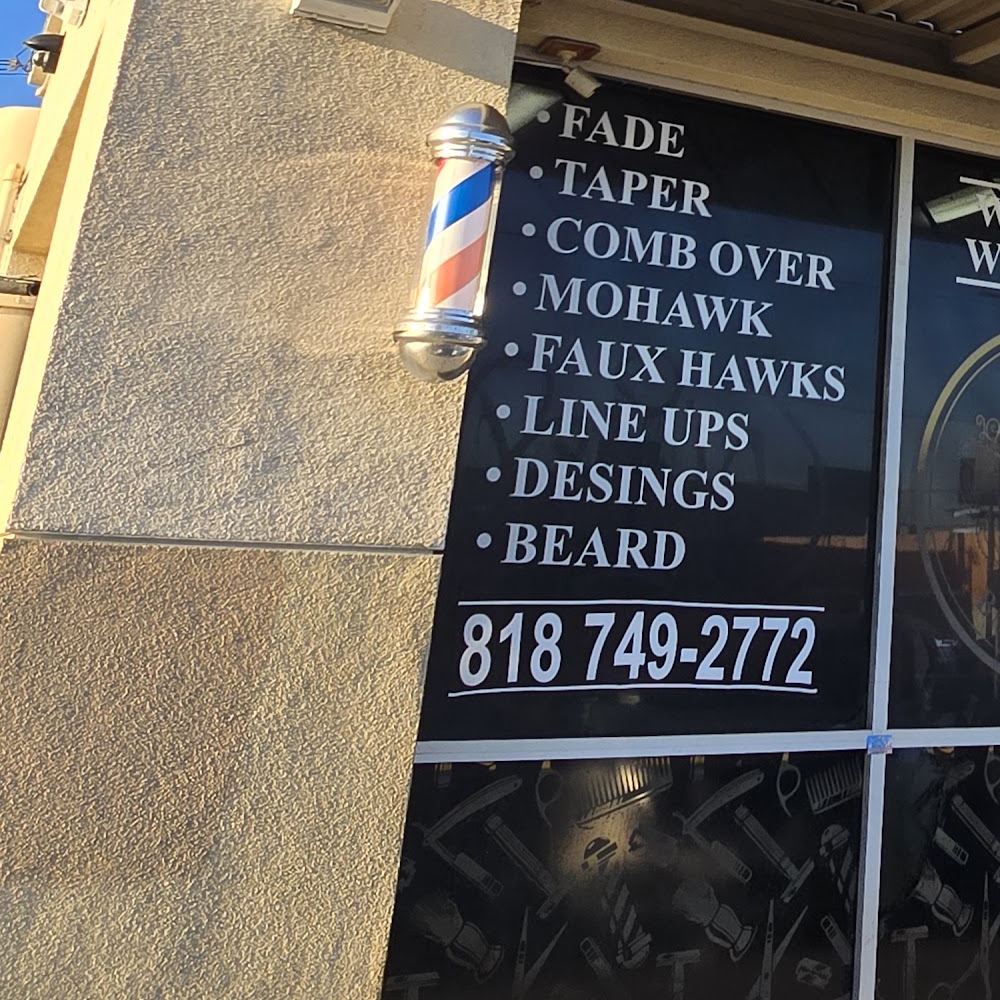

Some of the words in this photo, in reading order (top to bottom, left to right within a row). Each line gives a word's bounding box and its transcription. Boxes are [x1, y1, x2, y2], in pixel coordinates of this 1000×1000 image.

[559, 103, 685, 159] FADE
[554, 159, 712, 217] TAPER
[546, 217, 697, 270] COMB
[709, 240, 836, 291] OVER
[534, 274, 774, 338] MOHAWK
[527, 334, 669, 384] FAUX
[677, 349, 846, 401] HAWKS
[519, 394, 647, 443] LINE
[662, 407, 750, 451] UPS
[509, 457, 736, 511] DESINGS
[501, 522, 686, 570] BEARD
[458, 612, 563, 687] 818
[584, 610, 817, 685] 749-2772
